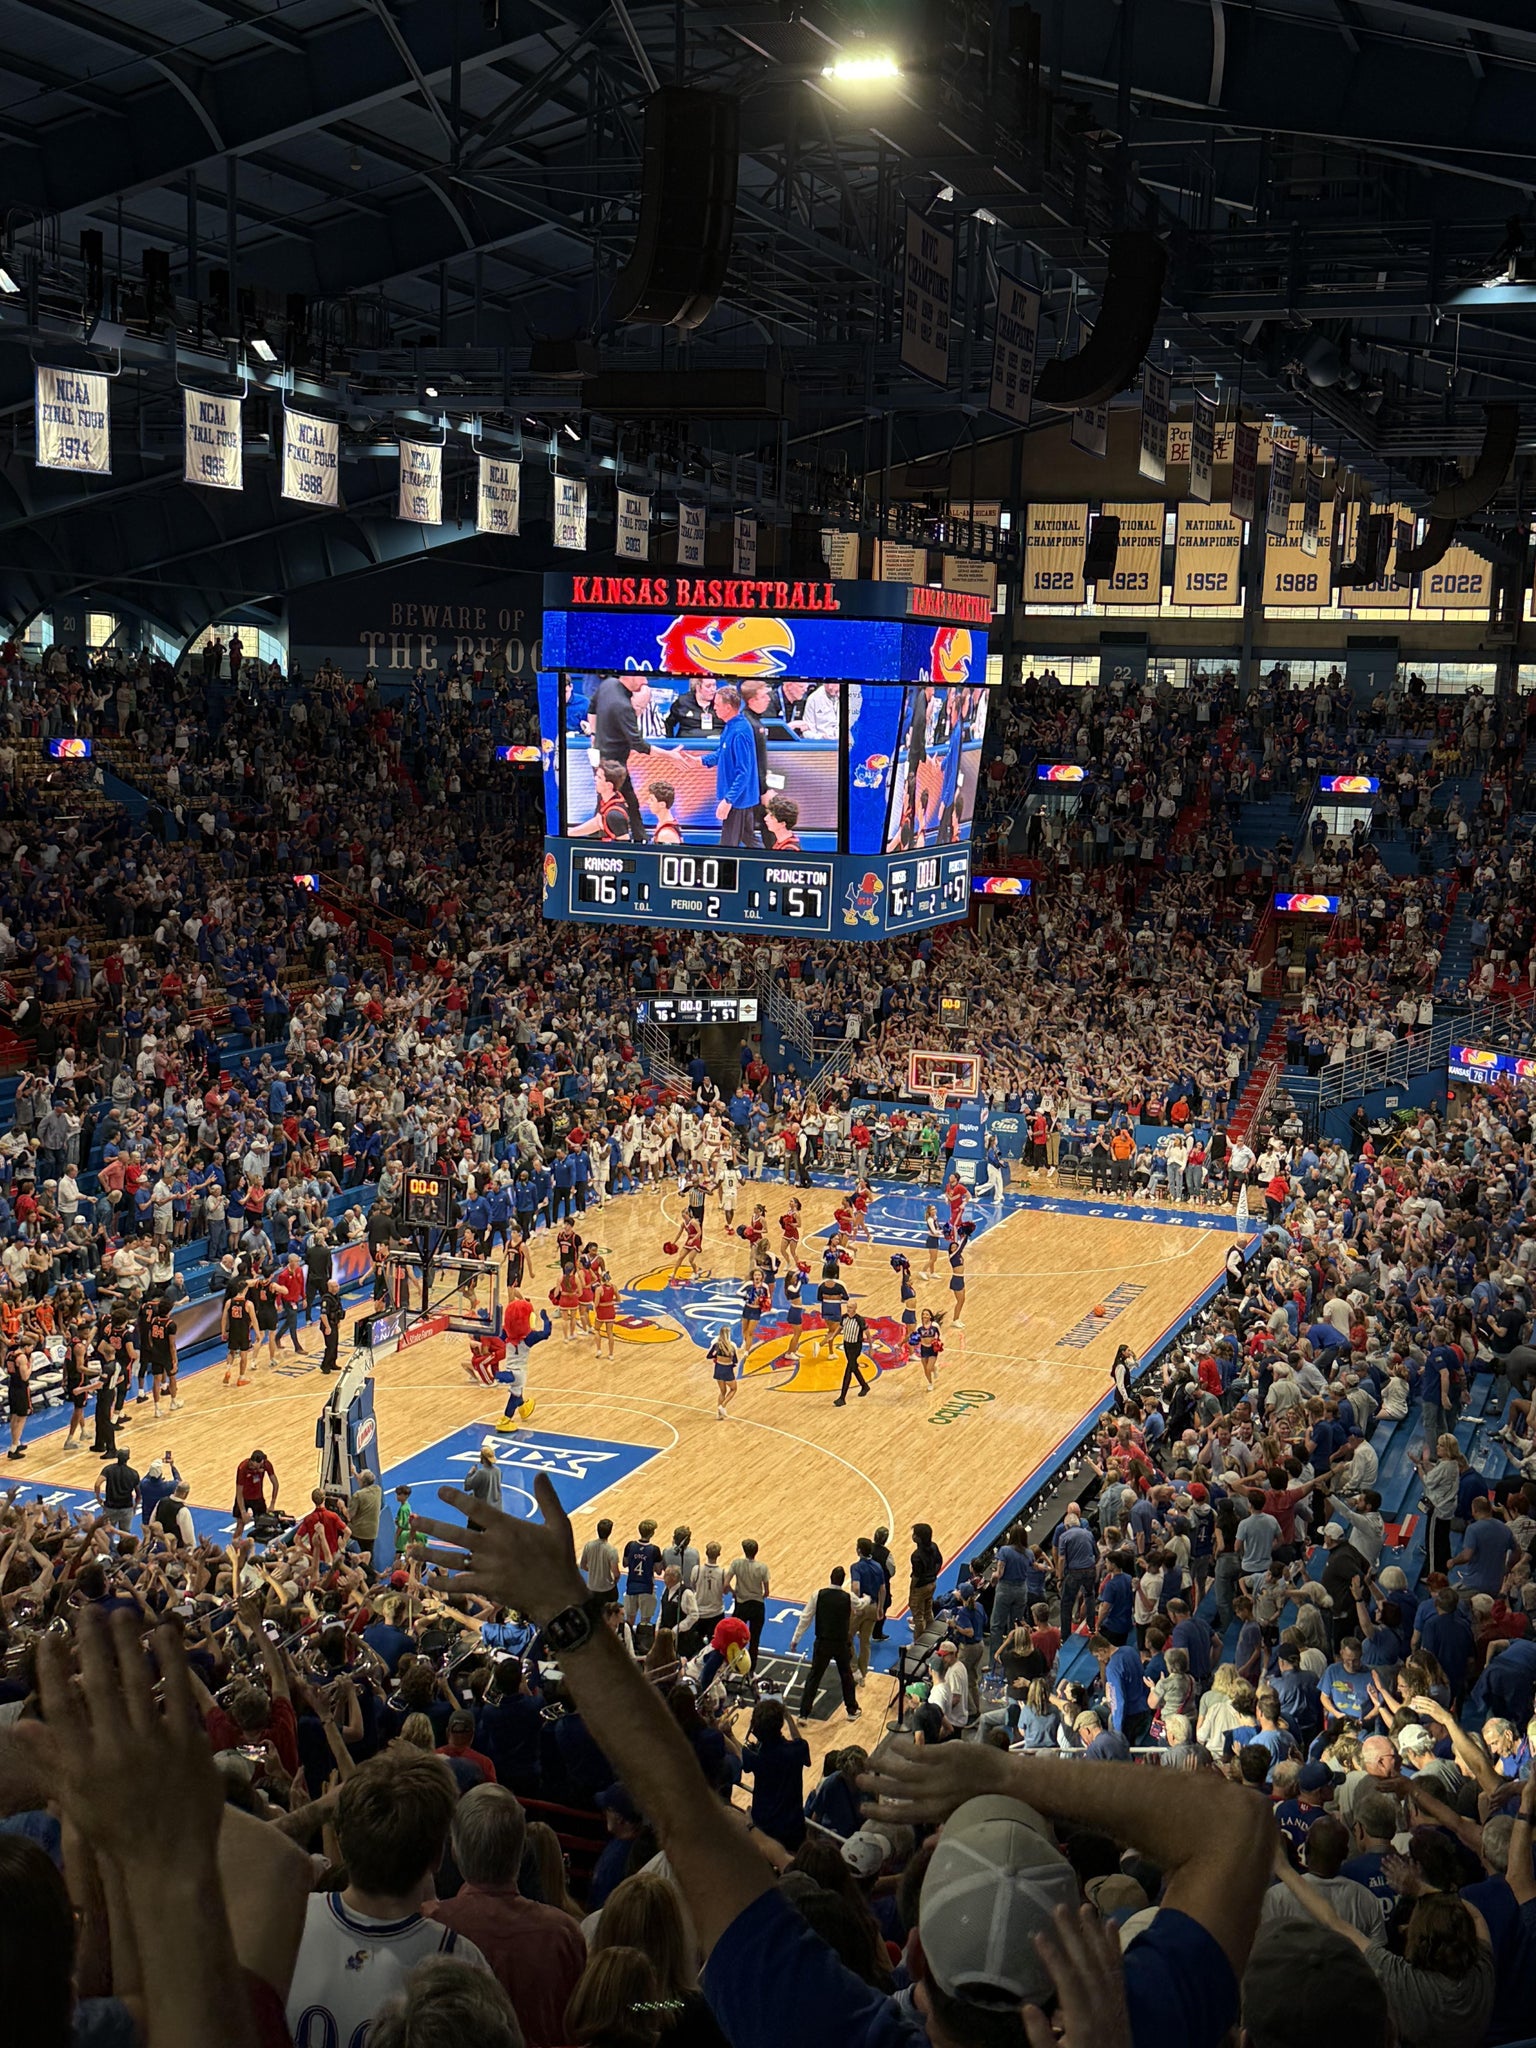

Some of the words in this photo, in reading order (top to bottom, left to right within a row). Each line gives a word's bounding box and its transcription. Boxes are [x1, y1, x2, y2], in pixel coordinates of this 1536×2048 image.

[57, 378, 90, 405] NCAA
[42, 403, 75, 425] FINAL
[79, 409, 105, 429] FOUR
[200, 401, 226, 426] NCAA
[298, 423, 324, 448] NCAA
[60, 437, 89, 461] 1974
[287, 443, 311, 464] FINAL
[314, 451, 337, 468] FOUR
[300, 473, 322, 495] 1988
[490, 465, 509, 485] NCAA
[500, 489, 517, 503] FOUR
[491, 509, 509, 527] 1993
[1034, 520, 1080, 531] NATIONAL
[1119, 520, 1156, 531] TIONAL
[1185, 520, 1235, 531] NATIONAL
[1027, 536, 1084, 547] CHAMPIONS
[1179, 536, 1239, 547] CHAMPIONS
[1034, 572, 1073, 590] 1922
[1186, 573, 1227, 591] 1952
[1276, 573, 1318, 592] 1988
[1431, 575, 1482, 593] 2022
[572, 576, 668, 606] KANSAS
[676, 579, 841, 611] BASKETBALL
[63, 615, 76, 632] 20
[391, 602, 486, 630] BEWARE
[498, 608, 525, 632] OF
[360, 631, 438, 671] THE
[1113, 665, 1132, 680] 22
[584, 857, 623, 873] KANSAS
[663, 857, 718, 889] 00.0
[766, 868, 826, 885] PRINCETON
[586, 875, 616, 904] 76
[634, 901, 652, 912] T.O.L.
[671, 899, 702, 911] PERIOD
[707, 896, 719, 918] 2
[789, 889, 821, 917] 57
[744, 909, 762, 920] T.O.L.
[656, 1009, 669, 1021] 76
[722, 1008, 736, 1020] 57
[680, 1000, 702, 1012] 00.0
[1448, 1066, 1470, 1077] KANSAS
[1474, 1070, 1484, 1081] 76
[410, 1179, 439, 1196] 00.0
[634, 1560, 644, 1576] 4
